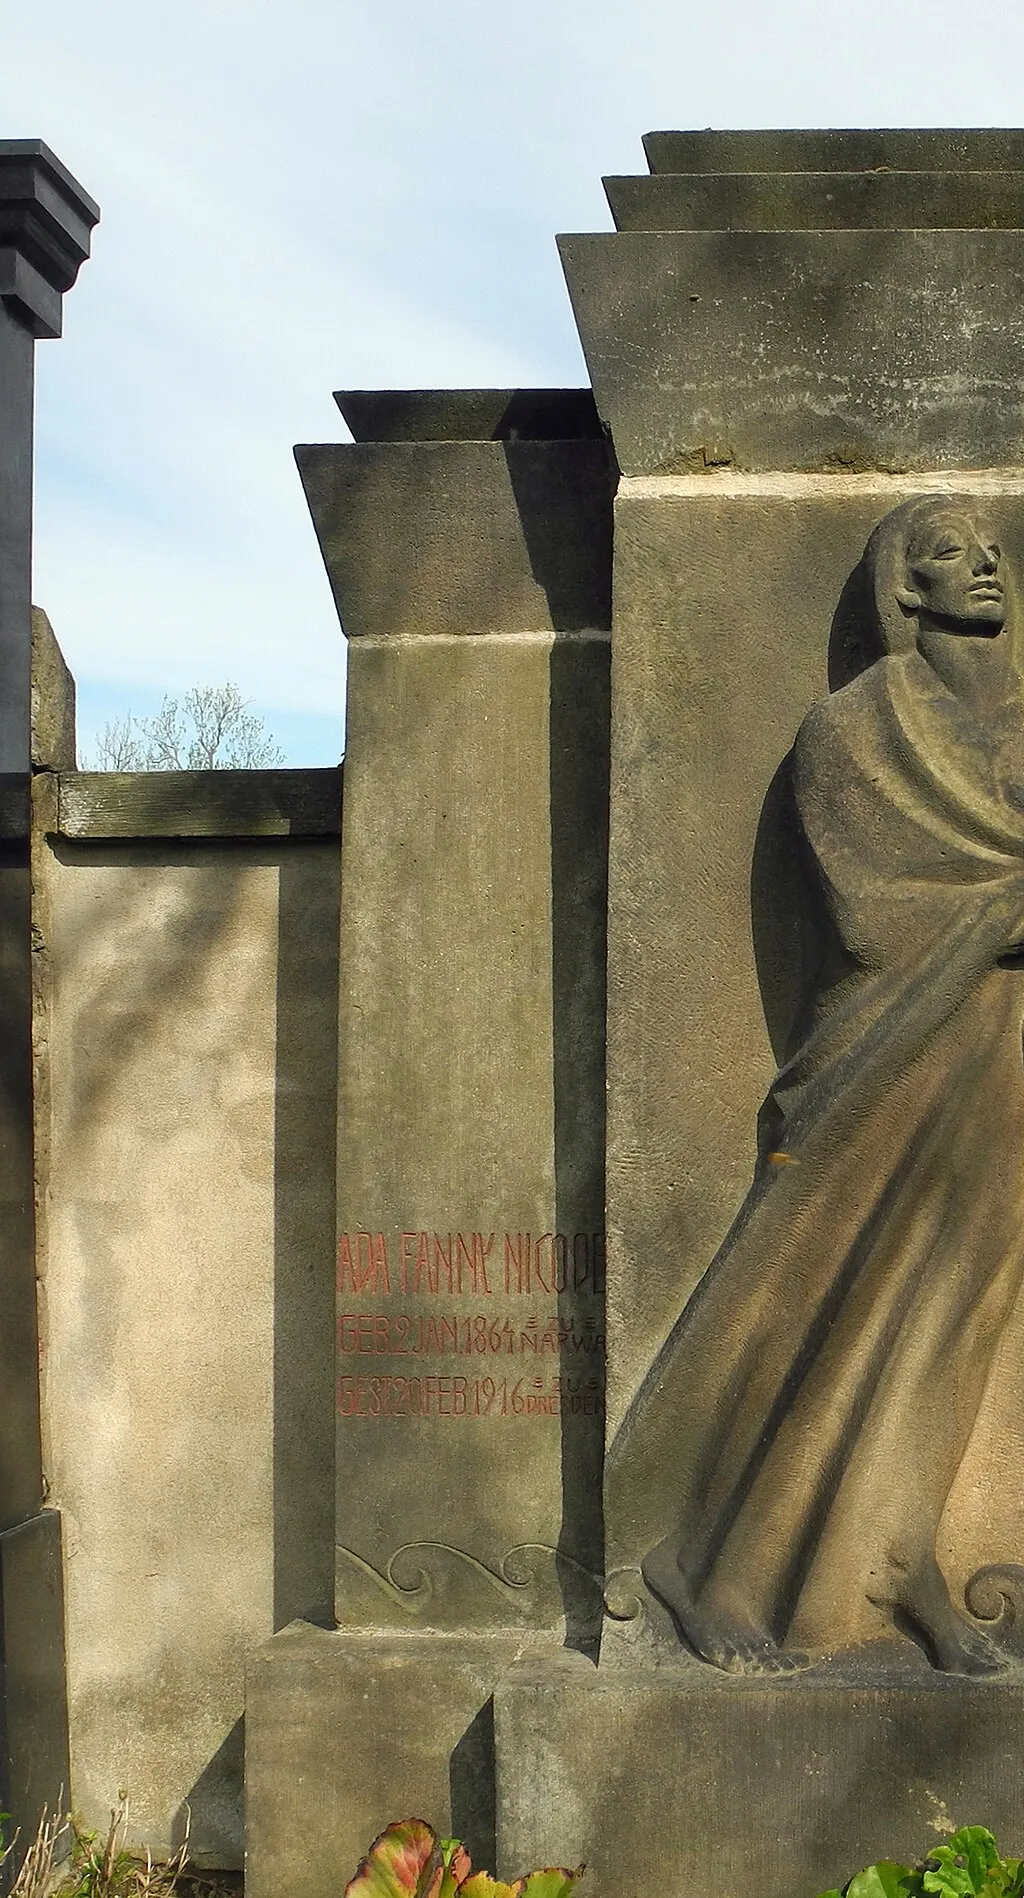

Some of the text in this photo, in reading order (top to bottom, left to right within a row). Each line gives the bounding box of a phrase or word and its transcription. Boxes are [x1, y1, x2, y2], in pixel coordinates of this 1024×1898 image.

[336, 1231, 391, 1294] ADA
[400, 1231, 495, 1294] FANNY
[465, 1315, 514, 1355] 1864
